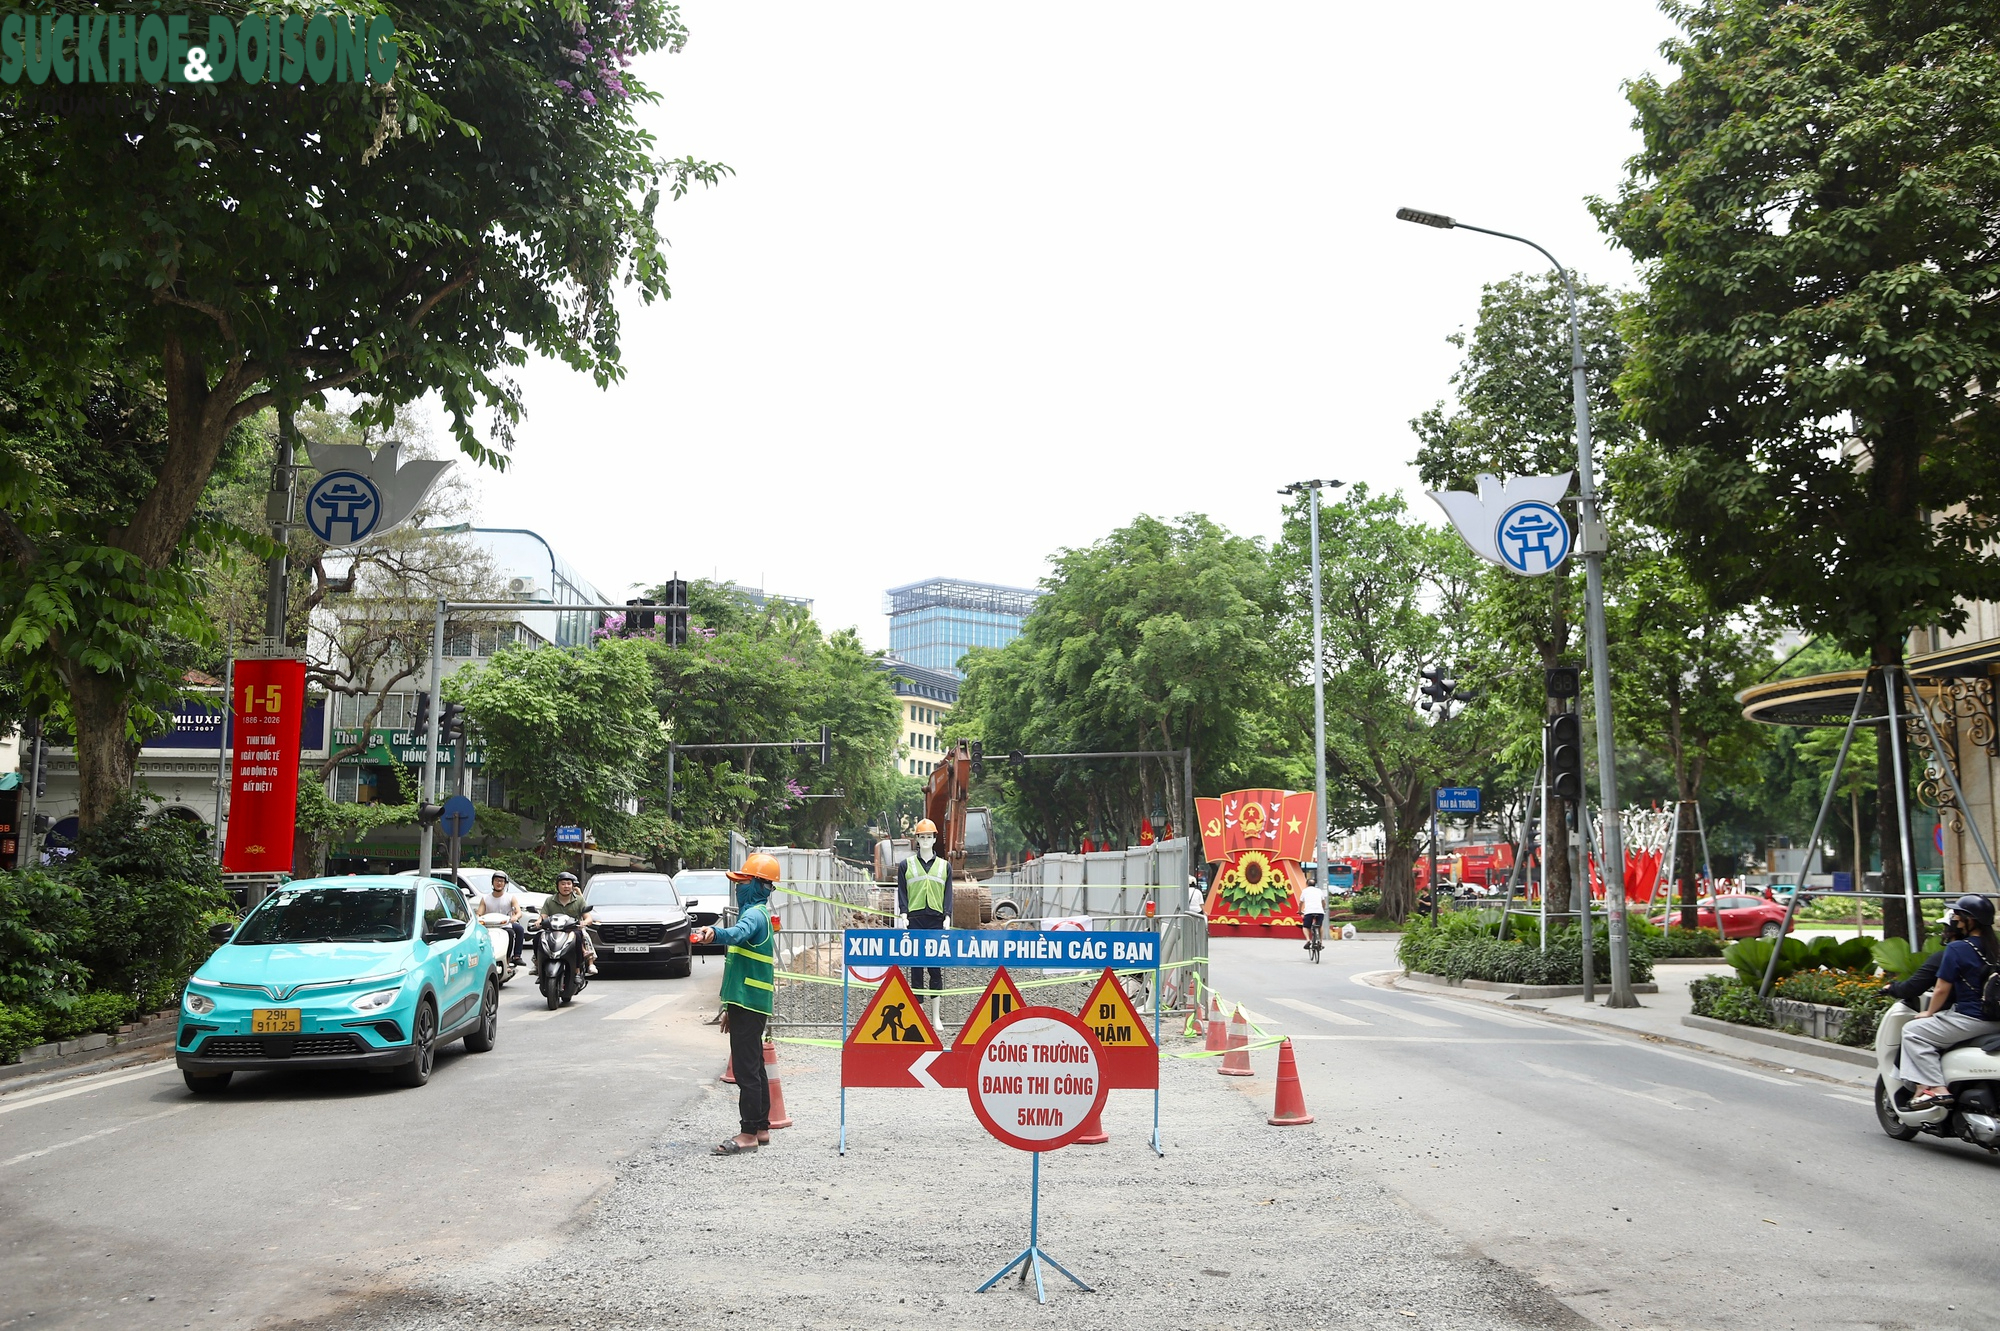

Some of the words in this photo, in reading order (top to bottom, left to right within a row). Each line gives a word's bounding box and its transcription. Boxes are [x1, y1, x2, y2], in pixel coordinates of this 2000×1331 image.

[244, 685, 282, 713] 1-5
[240, 767, 250, 776] LAO
[1440, 800, 1449, 808] HAI
[1450, 799, 1457, 808] BÀ
[848, 937, 883, 957] XIN
[889, 932, 919, 957] LỖI
[925, 933, 951, 957] ĐÃ
[957, 936, 998, 959] LÀM
[1003, 934, 1062, 959] PHIỀN
[1067, 937, 1107, 960] CÁC
[1112, 942, 1153, 964] BẠN
[266, 1010, 287, 1020] 29H
[1099, 1004, 1115, 1019] ĐI
[257, 1022, 295, 1031] 911.25
[1089, 1023, 1131, 1045] HẬM
[988, 1041, 1027, 1063] CÔNG
[1032, 1040, 1089, 1064] TRƯỜNG
[982, 1076, 1023, 1095] ĐANG
[1026, 1076, 1049, 1095] THI
[1053, 1072, 1093, 1096] CÔNG
[1017, 1108, 1063, 1127] 5KM/h
